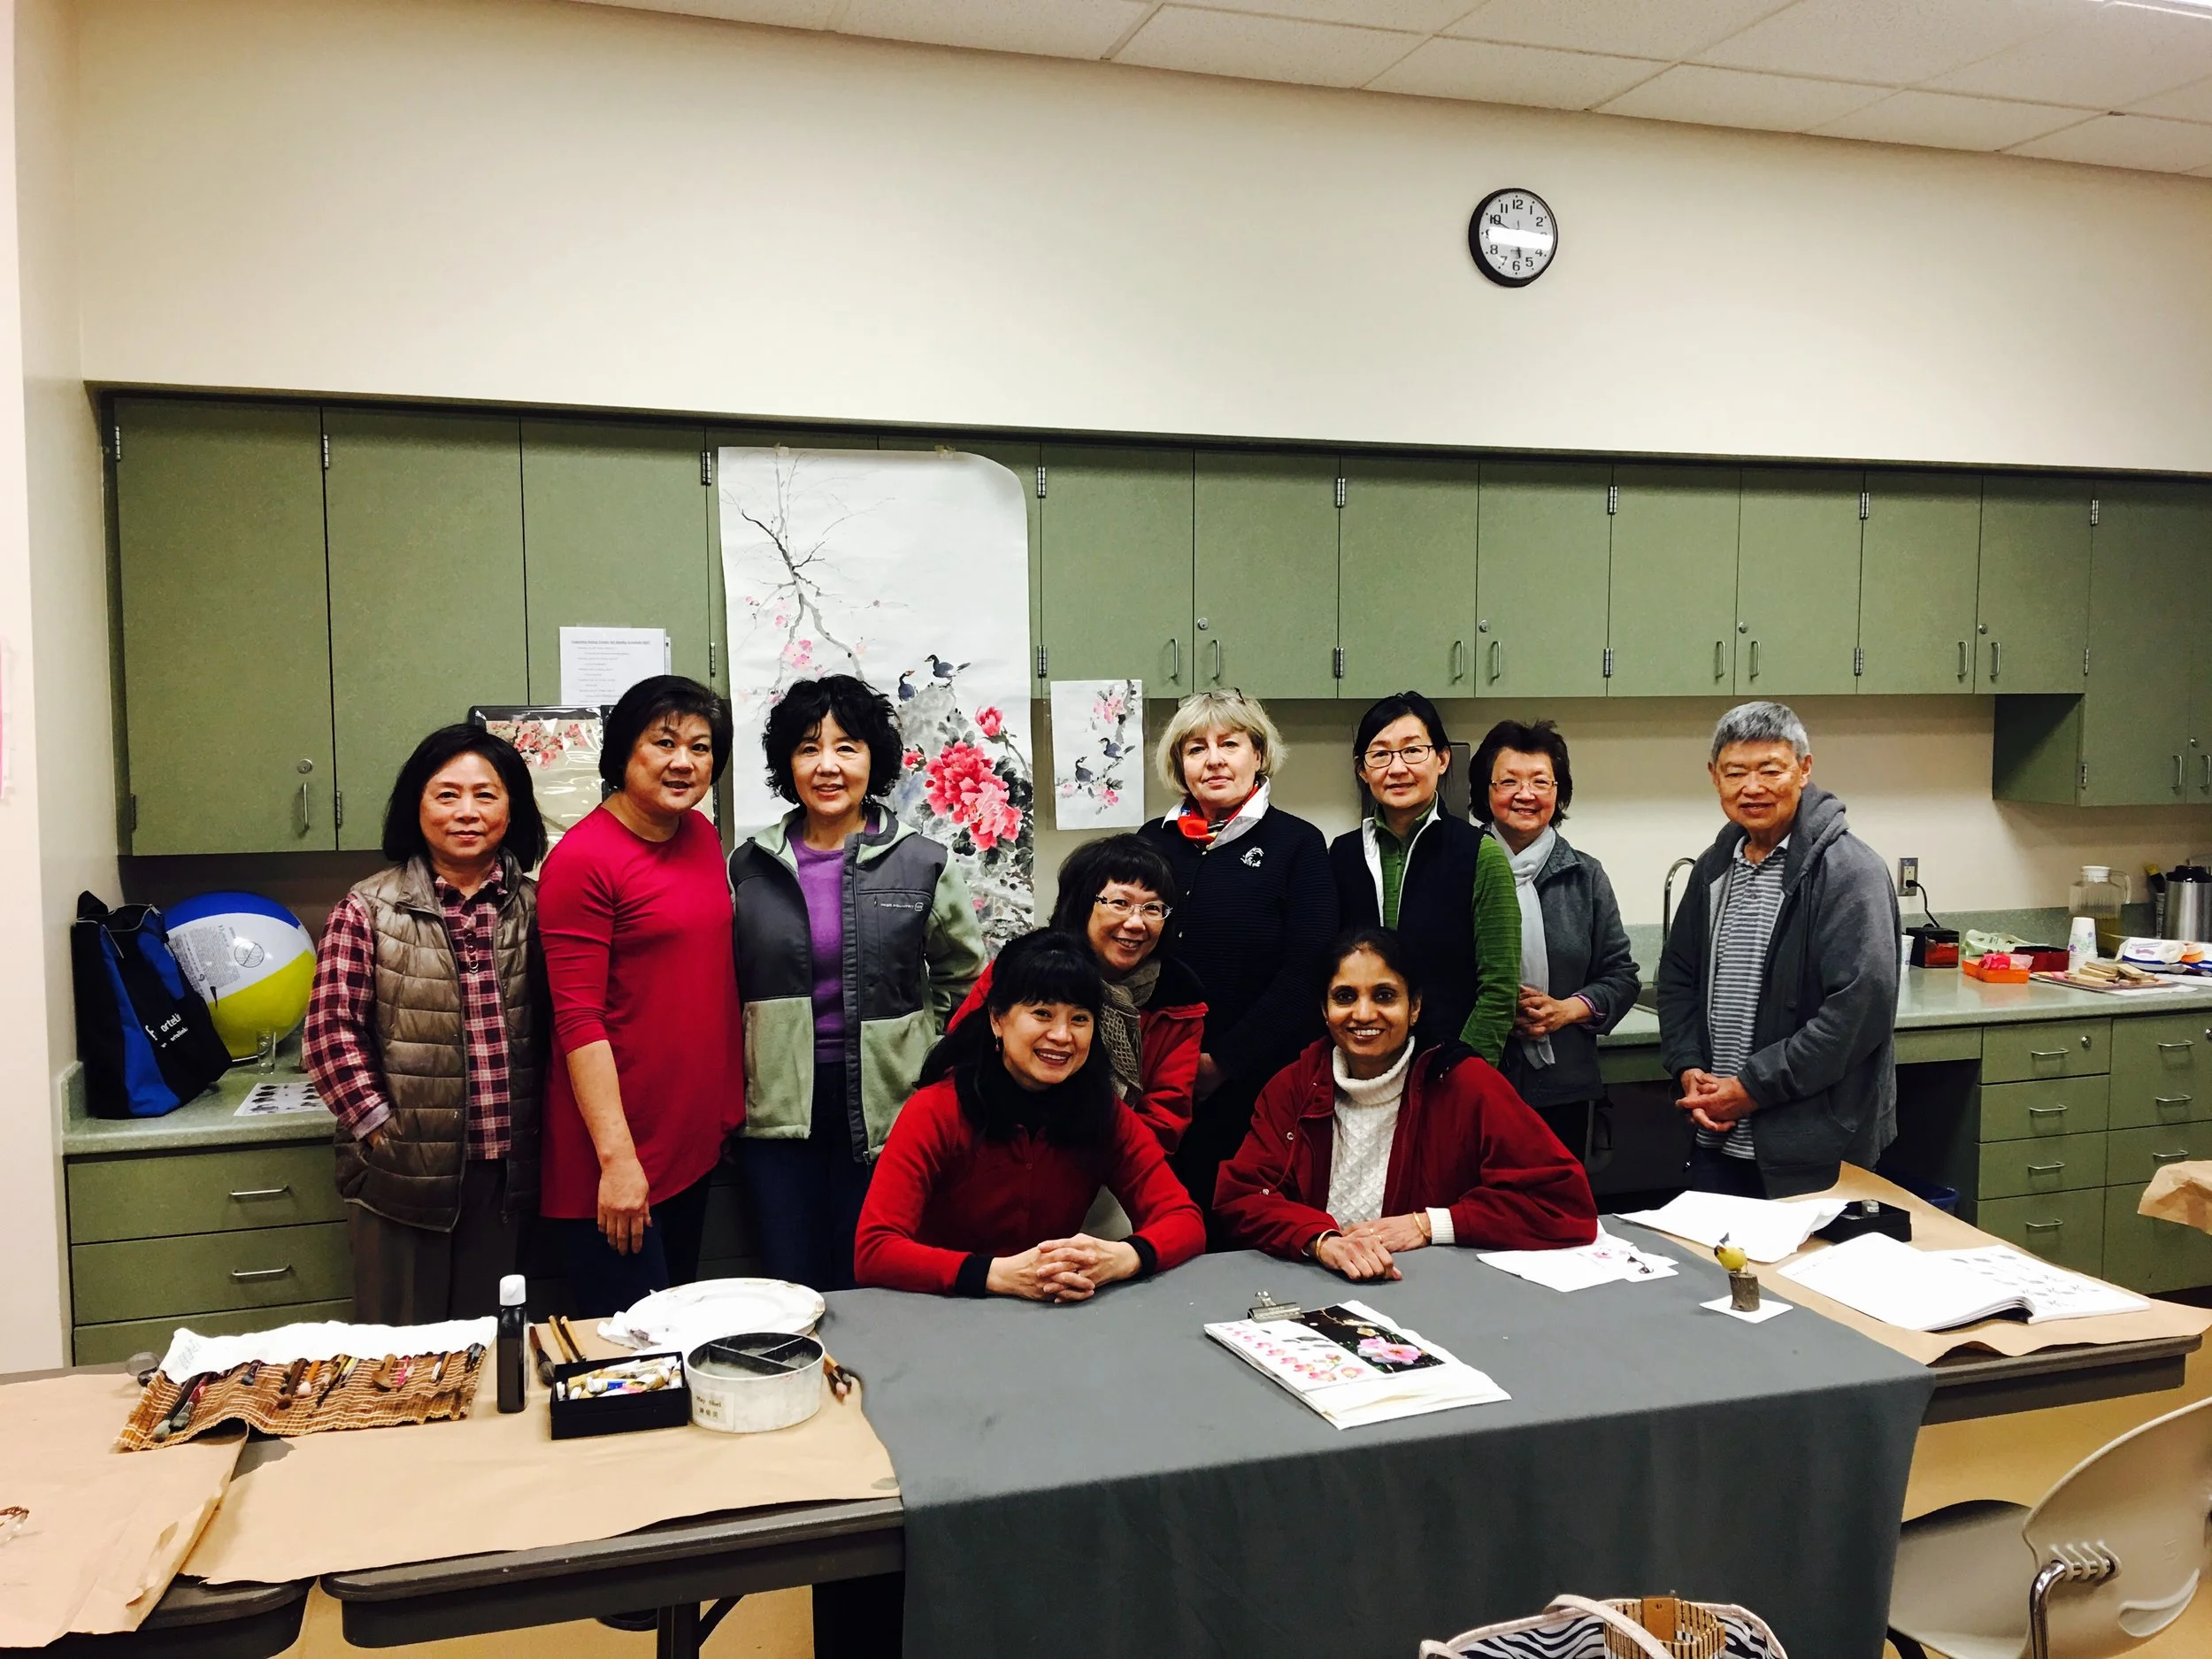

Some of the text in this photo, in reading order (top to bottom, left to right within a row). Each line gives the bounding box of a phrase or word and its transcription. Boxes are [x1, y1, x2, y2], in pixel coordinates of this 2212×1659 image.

[1500, 203, 1509, 213] 11
[1512, 199, 1524, 210] 12
[1489, 214, 1502, 225] 10
[1535, 217, 1544, 227] 2
[1489, 244, 1499, 255] 8
[1535, 249, 1543, 257] 4
[1500, 255, 1508, 265] 7
[1525, 257, 1534, 267] 5
[1512, 261, 1521, 272] 6
